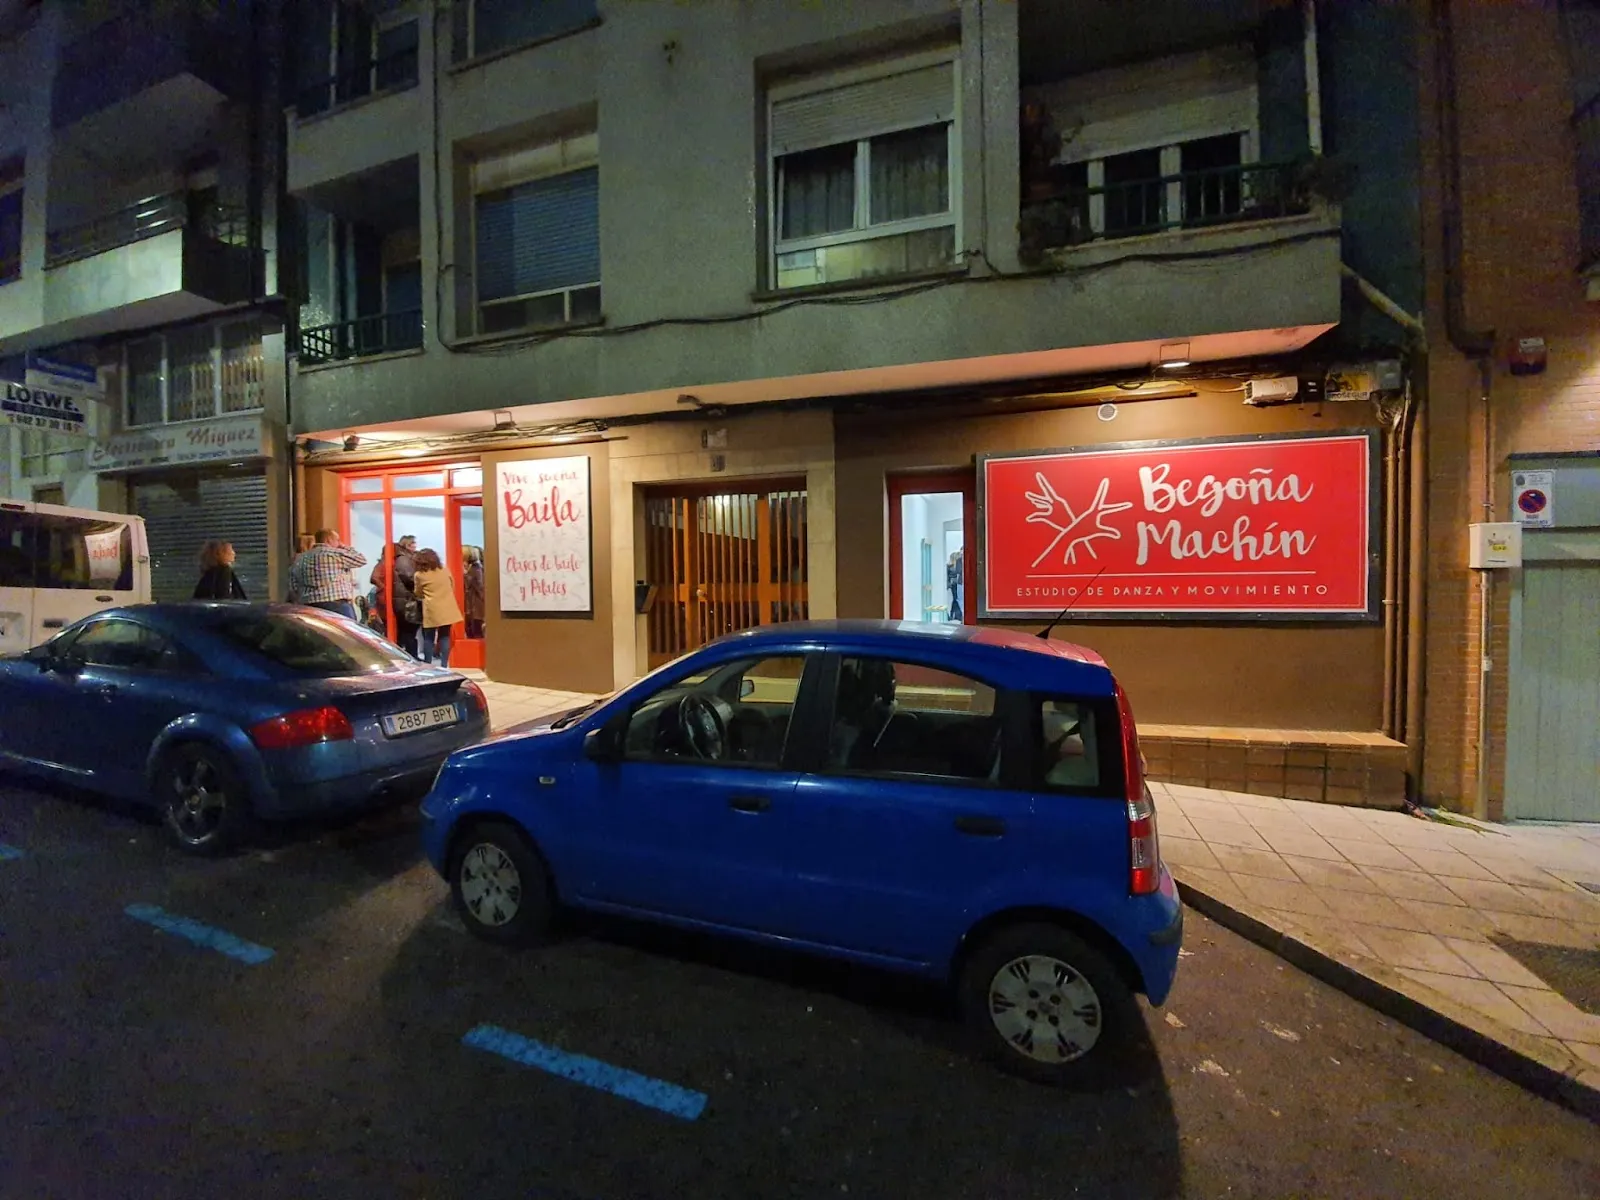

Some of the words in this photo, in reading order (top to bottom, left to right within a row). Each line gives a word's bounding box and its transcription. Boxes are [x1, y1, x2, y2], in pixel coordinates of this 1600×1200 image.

[1138, 463, 1314, 517] Begoña
[504, 486, 579, 529] Baila
[1135, 515, 1318, 566] Machín
[506, 555, 537, 573] Clases
[540, 554, 551, 571] de
[554, 553, 580, 572] baile
[519, 586, 526, 601] y
[530, 577, 567, 597] Pilates
[1016, 587, 1078, 597] ESTUDIO
[1087, 586, 1104, 596] DE
[1113, 586, 1164, 596] DANZA
[1171, 586, 1180, 596] Y
[1187, 585, 1328, 596] MOVIMIENTO
[397, 712, 427, 730] 2887
[432, 707, 453, 723] BPY
